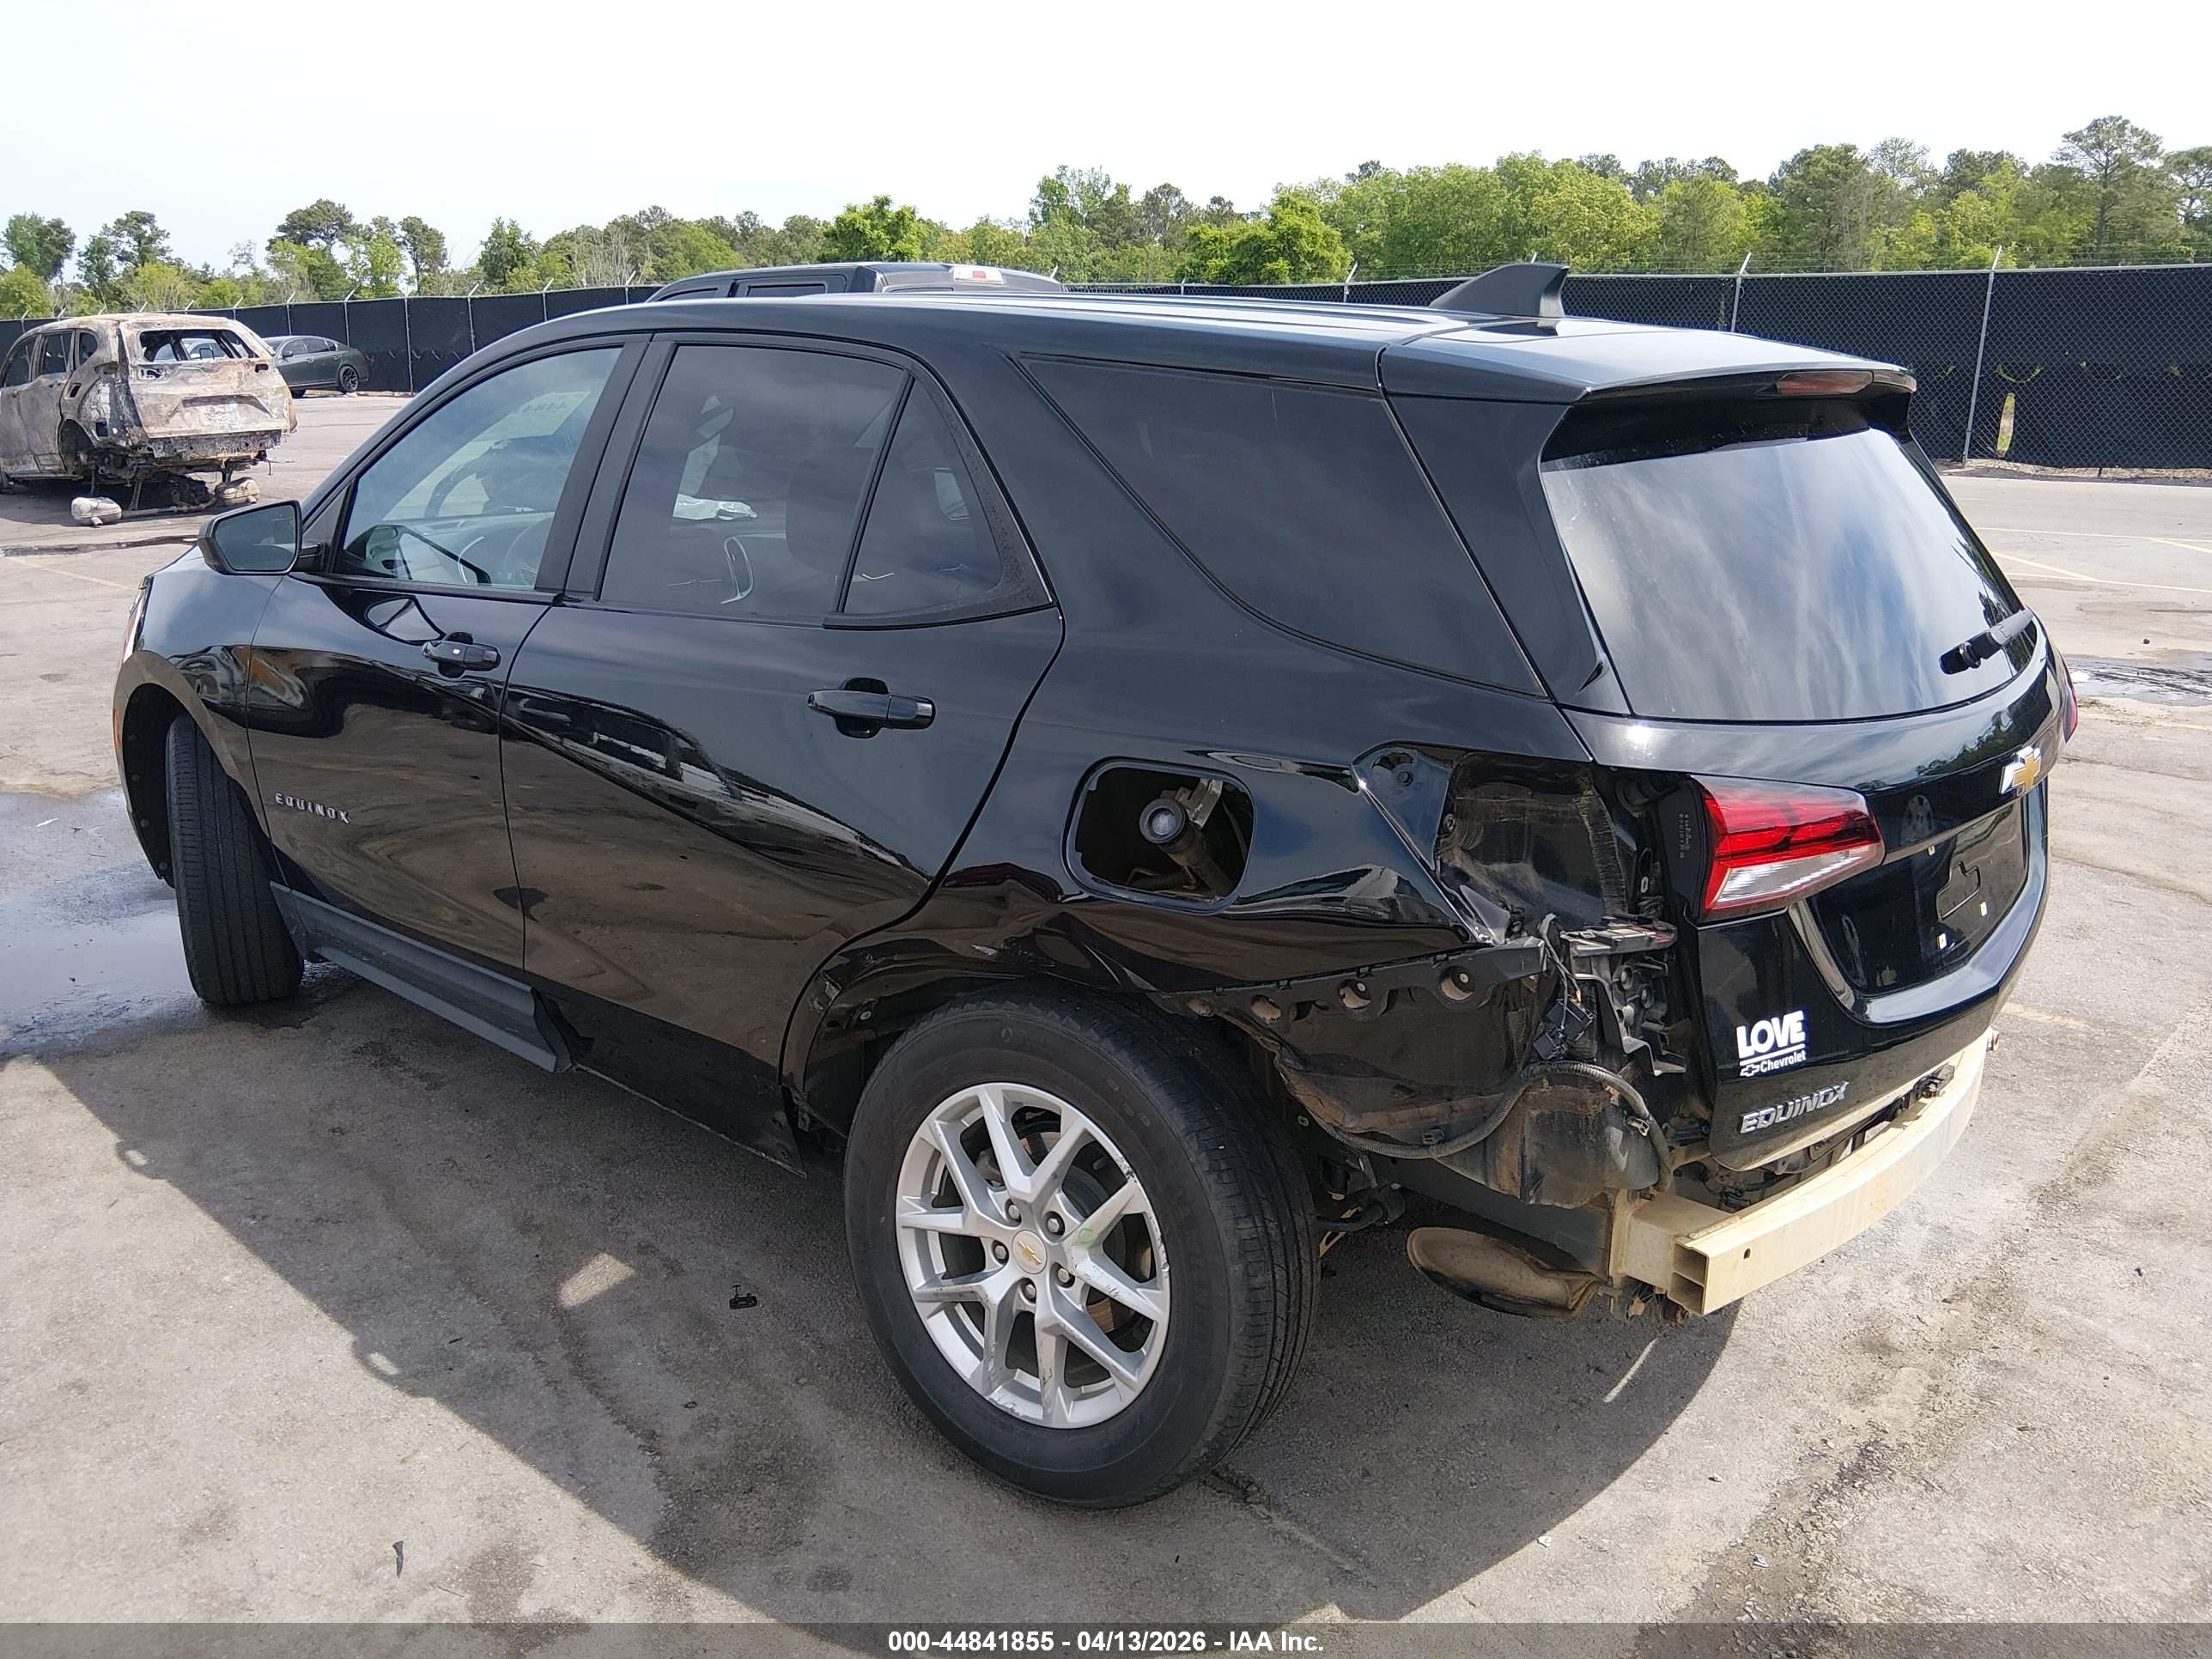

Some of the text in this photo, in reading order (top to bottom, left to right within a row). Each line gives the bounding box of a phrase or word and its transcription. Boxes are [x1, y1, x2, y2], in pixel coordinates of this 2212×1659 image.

[275, 793, 350, 823] EQUINOX
[1736, 1010, 1805, 1058] LOVE
[1760, 1050, 1807, 1073] Chevrolet
[1738, 1081, 1850, 1134] EQUINOX
